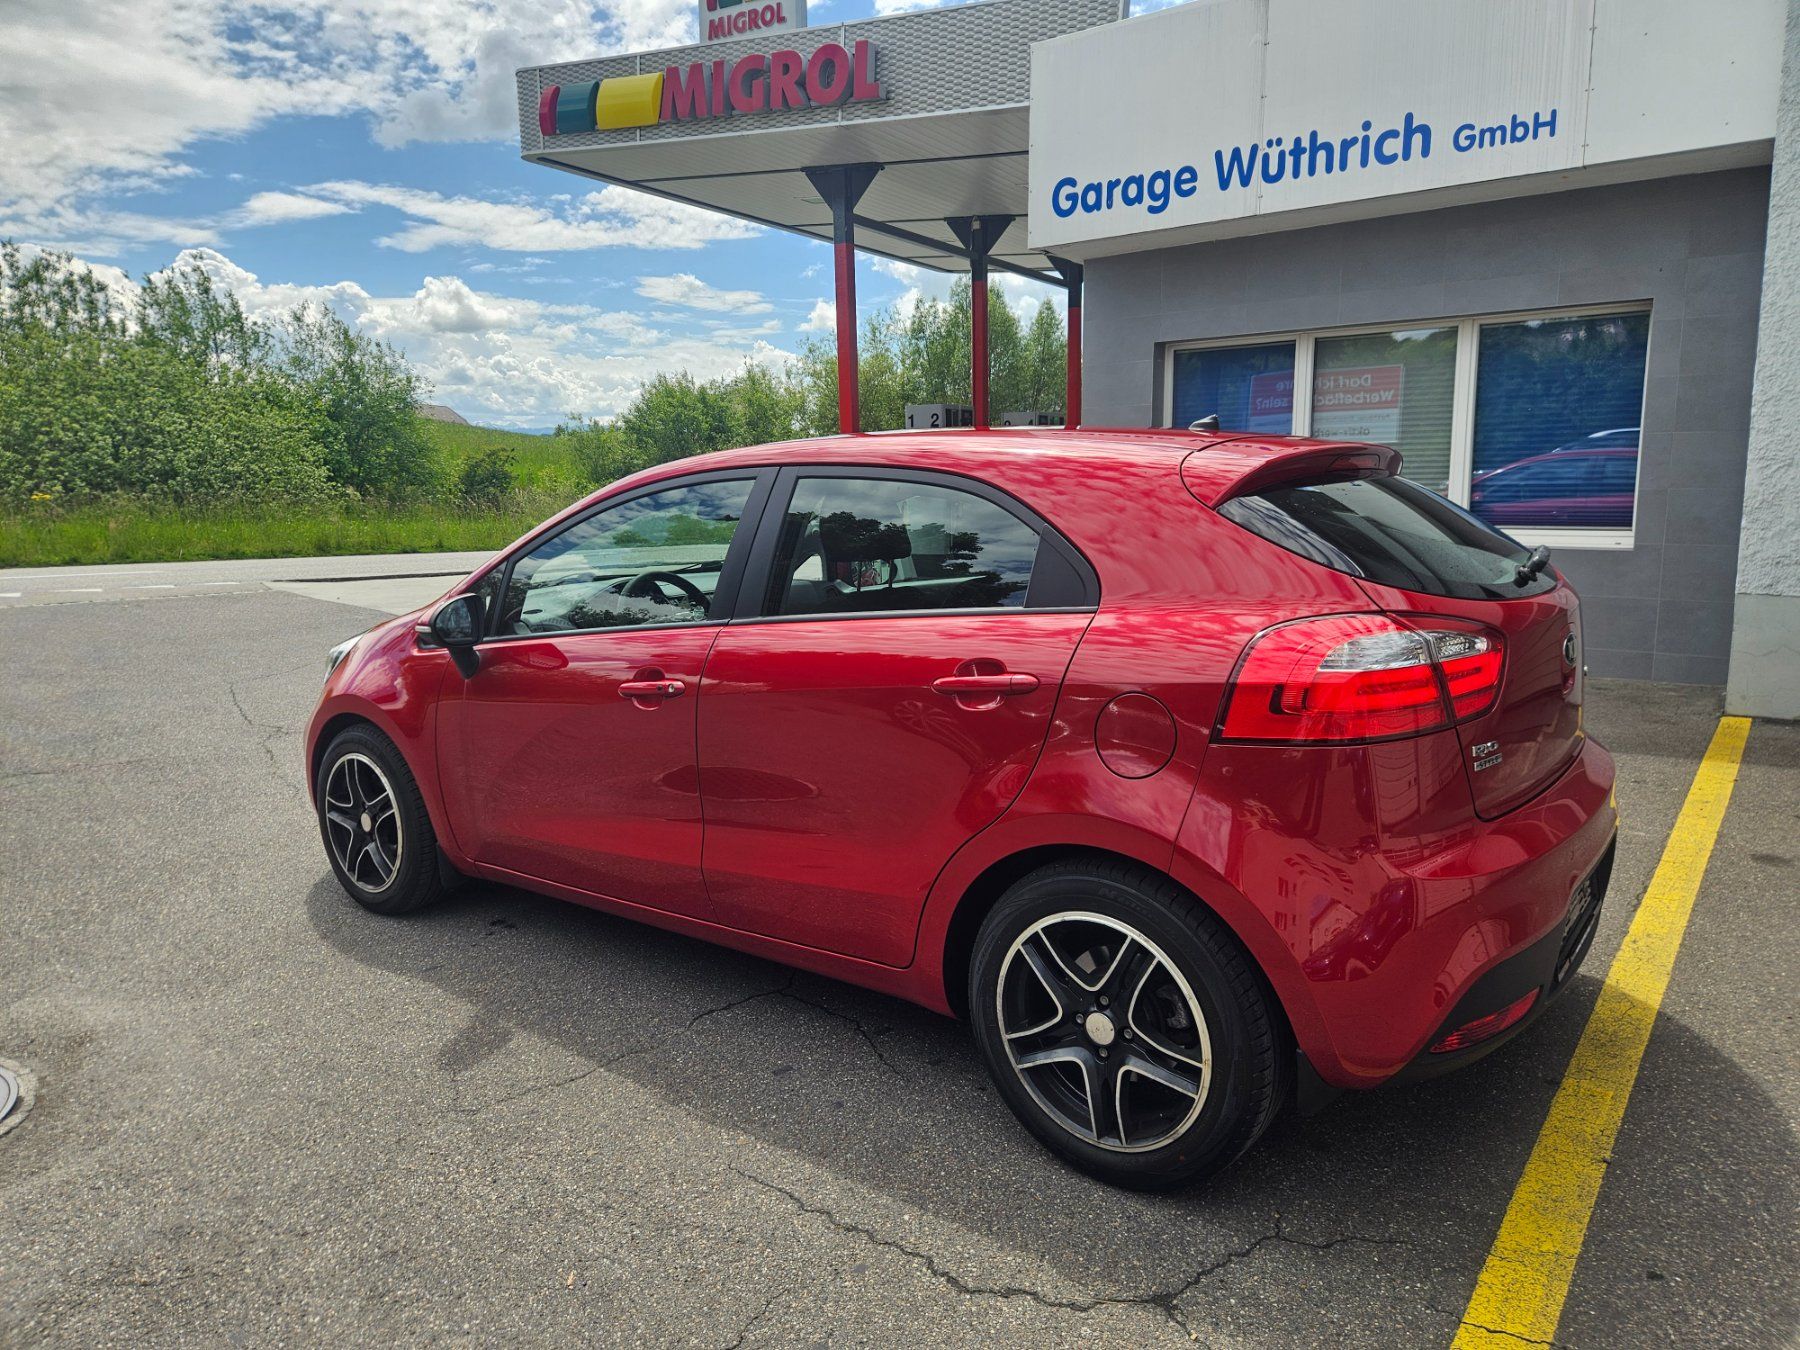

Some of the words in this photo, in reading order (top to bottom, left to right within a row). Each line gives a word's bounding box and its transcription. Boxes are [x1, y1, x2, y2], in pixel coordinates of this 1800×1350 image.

[707, 2, 787, 41] MIGROL
[660, 40, 883, 121] MIGROL
[1052, 165, 1198, 219] Garage
[1214, 112, 1432, 192] Wüthrich
[1452, 109, 1557, 153] GmbH
[908, 414, 914, 428] 1
[930, 413, 940, 428] 2
